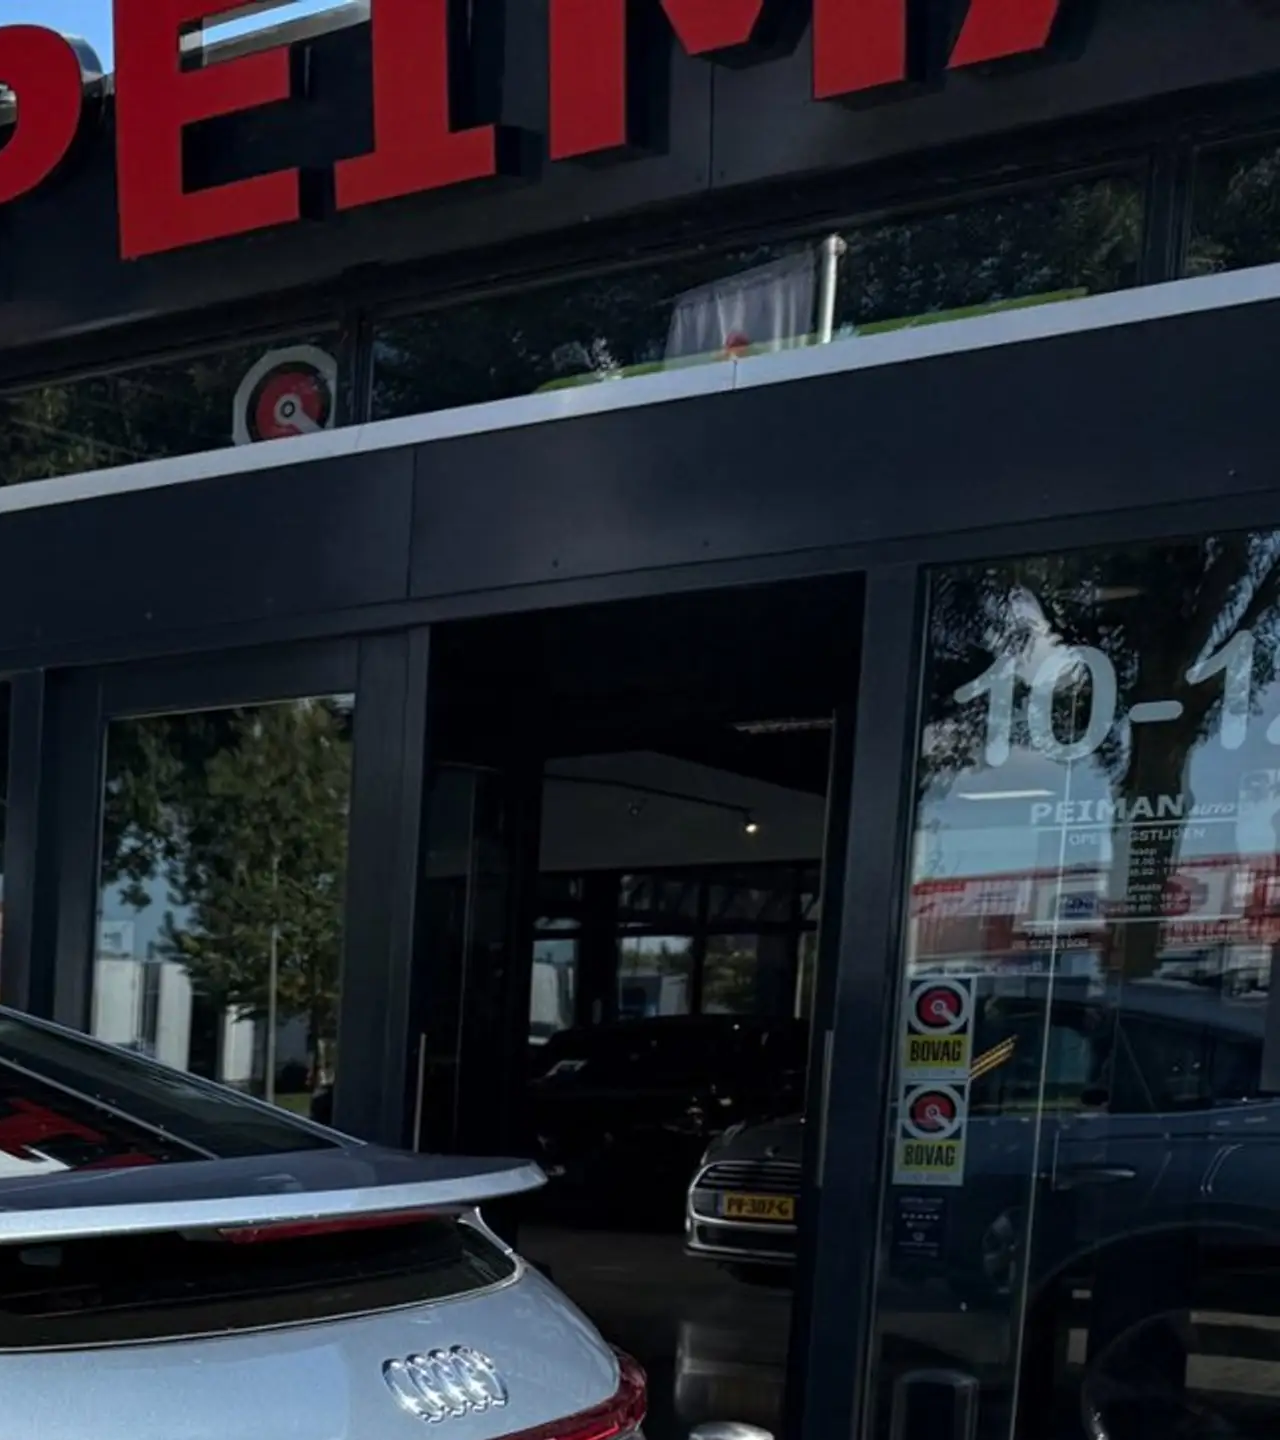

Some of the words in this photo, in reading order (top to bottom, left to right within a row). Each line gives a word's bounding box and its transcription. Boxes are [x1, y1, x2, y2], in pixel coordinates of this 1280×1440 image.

[953, 629, 1280, 768] 10-1
[1030, 794, 1185, 824] PEIMAN
[909, 1039, 963, 1063] BOVAG
[902, 1144, 957, 1168] BOVAG
